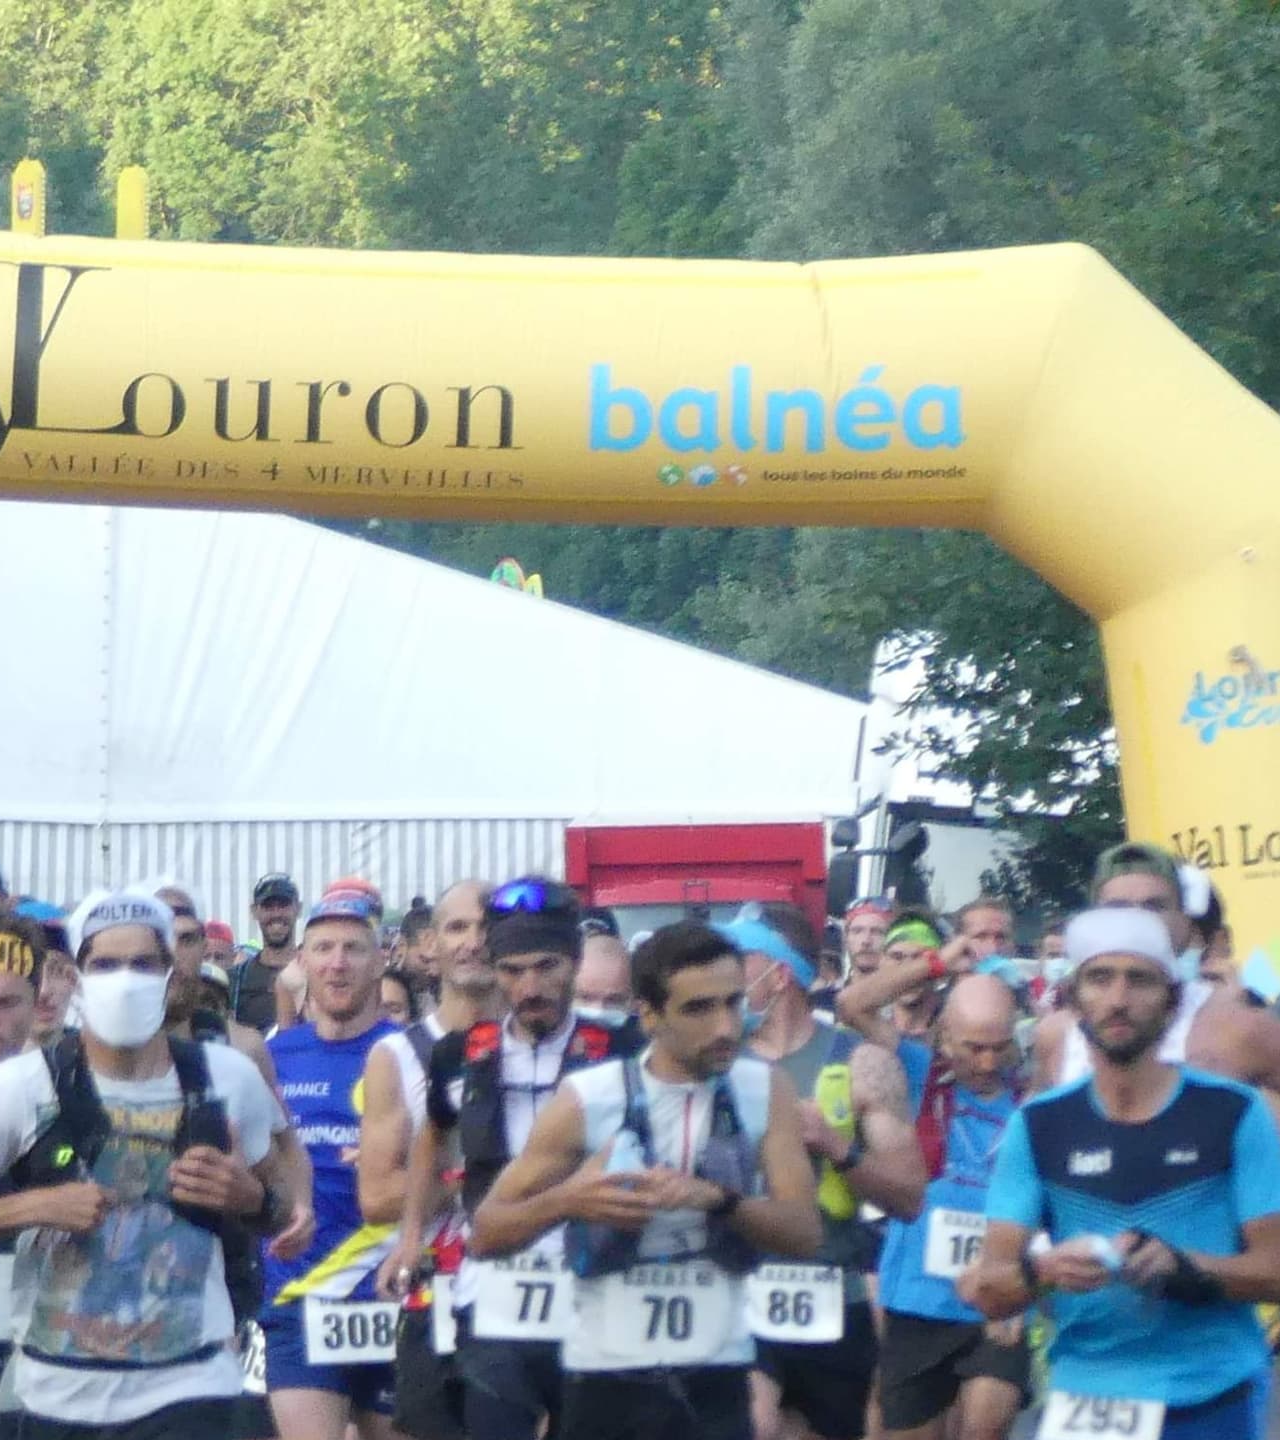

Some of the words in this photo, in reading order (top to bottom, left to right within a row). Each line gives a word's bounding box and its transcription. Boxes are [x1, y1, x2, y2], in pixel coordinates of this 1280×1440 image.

[588, 363, 967, 453] balnéa
[22, 449, 155, 477] VALLÉE
[175, 458, 240, 480] DES
[260, 462, 281, 482] 4
[305, 464, 526, 488] MERVEILLES
[1171, 825, 1231, 870] Val
[516, 1280, 555, 1323] 77
[642, 1294, 694, 1342] 70
[767, 1289, 814, 1327] 86
[322, 1311, 396, 1350] 308
